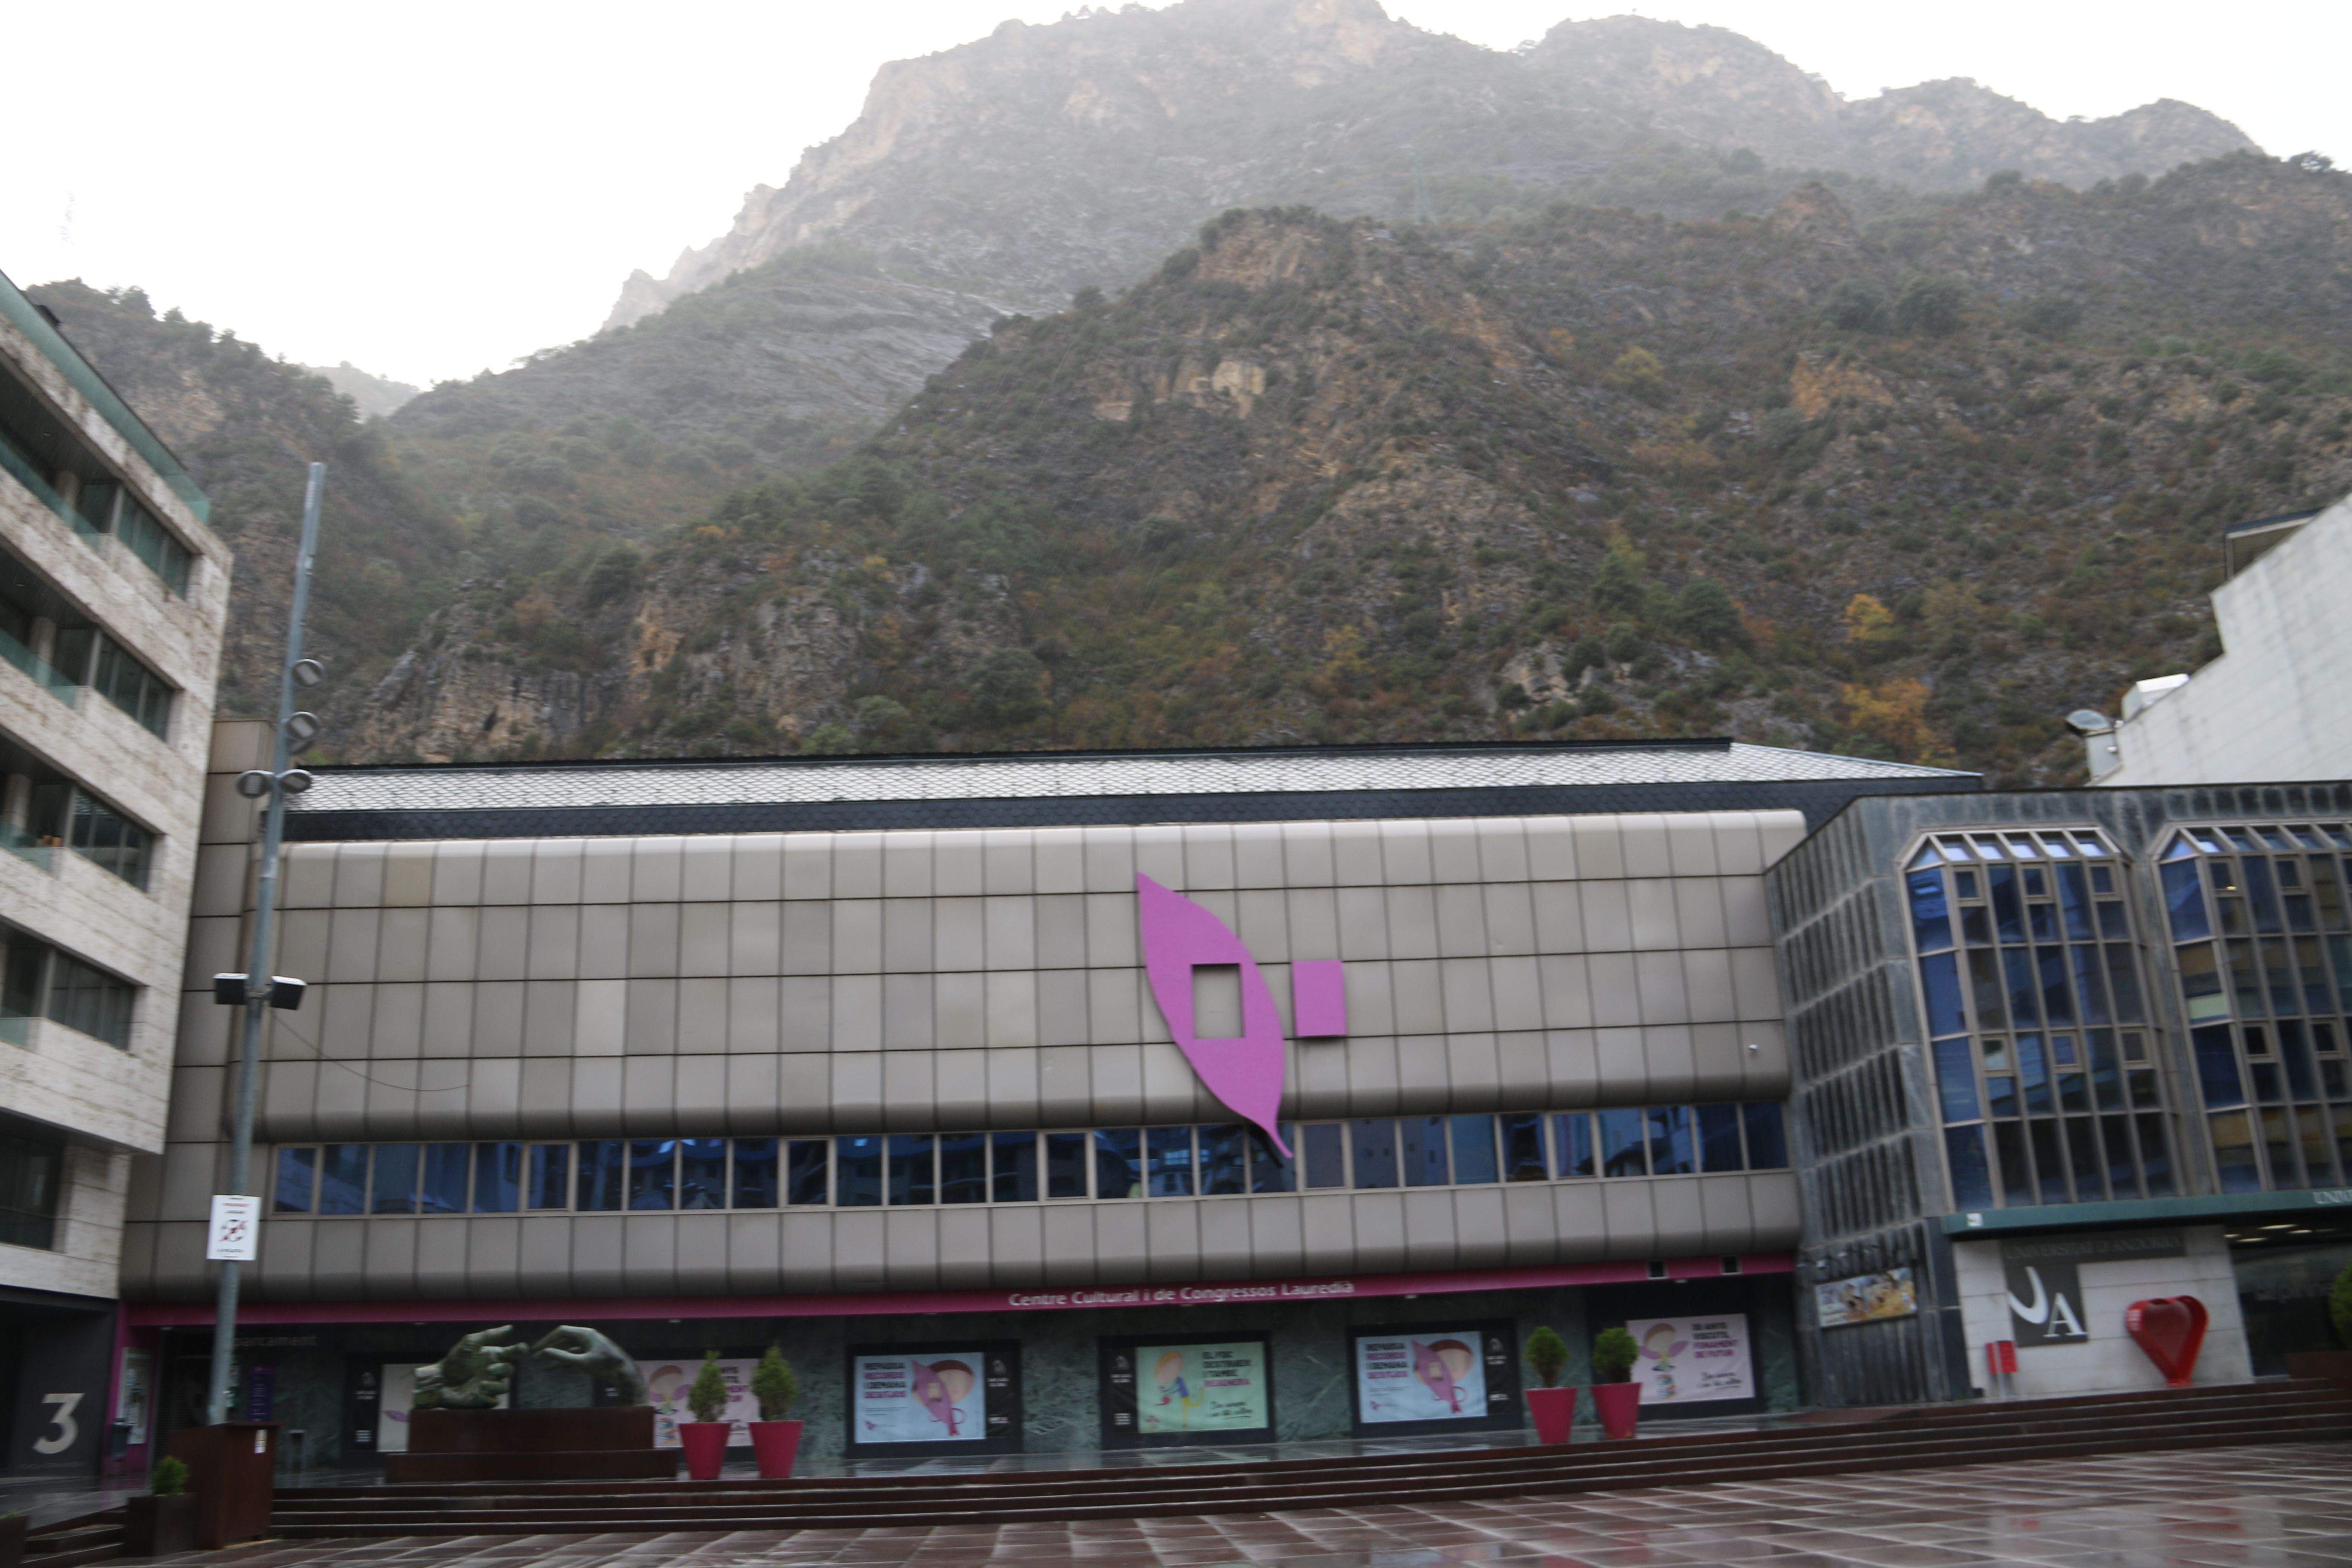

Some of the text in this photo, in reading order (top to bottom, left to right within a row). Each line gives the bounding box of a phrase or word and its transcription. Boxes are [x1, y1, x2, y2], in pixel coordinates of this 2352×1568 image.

[1008, 1281, 1354, 1305] Centre Cultural i de Congressos Lauredià
[32, 1393, 85, 1454] 3
